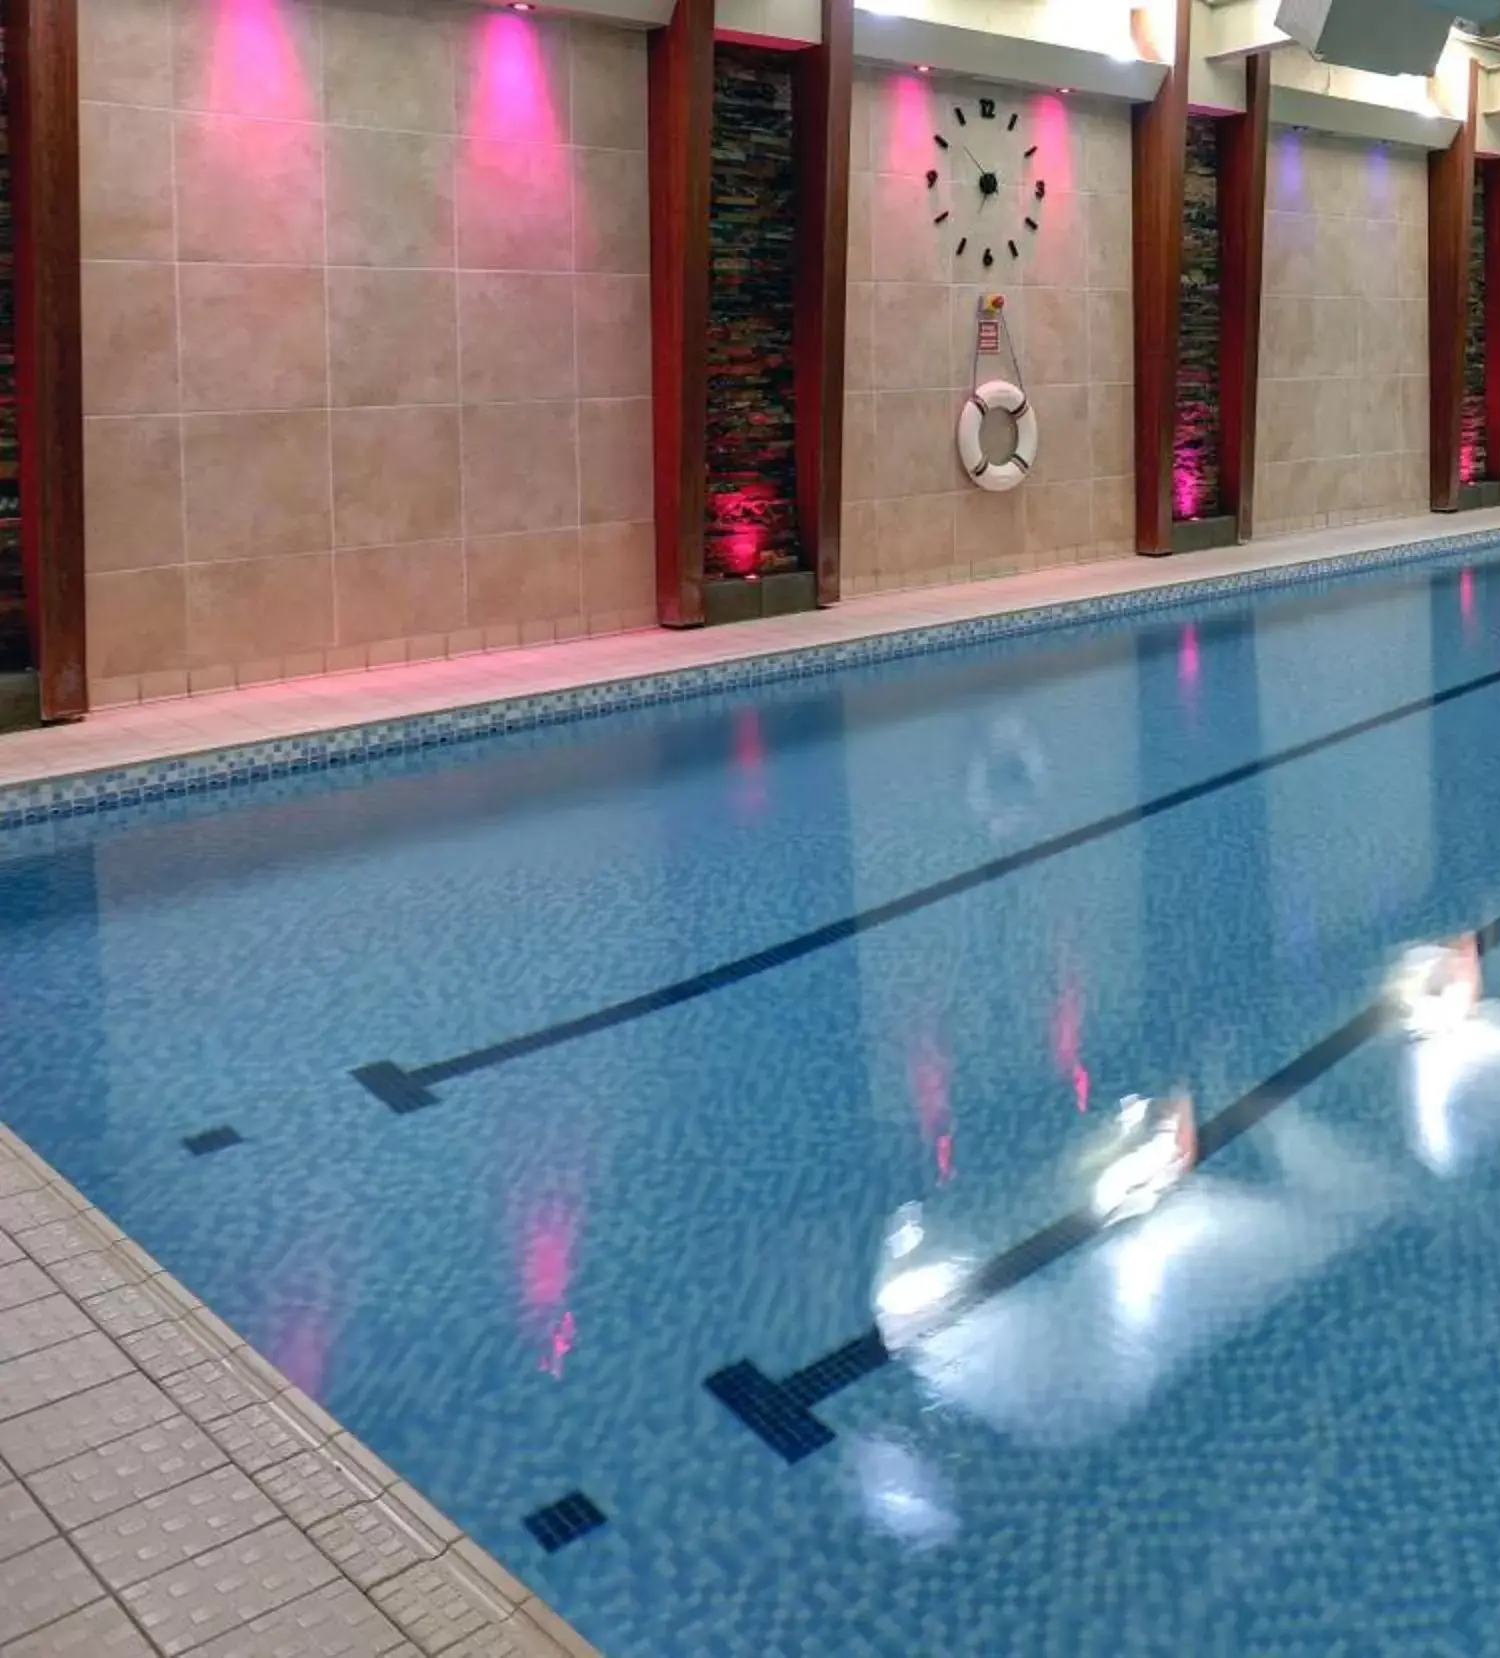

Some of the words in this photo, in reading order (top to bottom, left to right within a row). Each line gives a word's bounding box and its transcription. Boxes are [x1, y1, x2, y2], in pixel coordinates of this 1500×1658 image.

[980, 98, 995, 119] 12
[926, 170, 938, 188] 9
[1035, 180, 1045, 200] 3
[982, 248, 993, 268] 6
